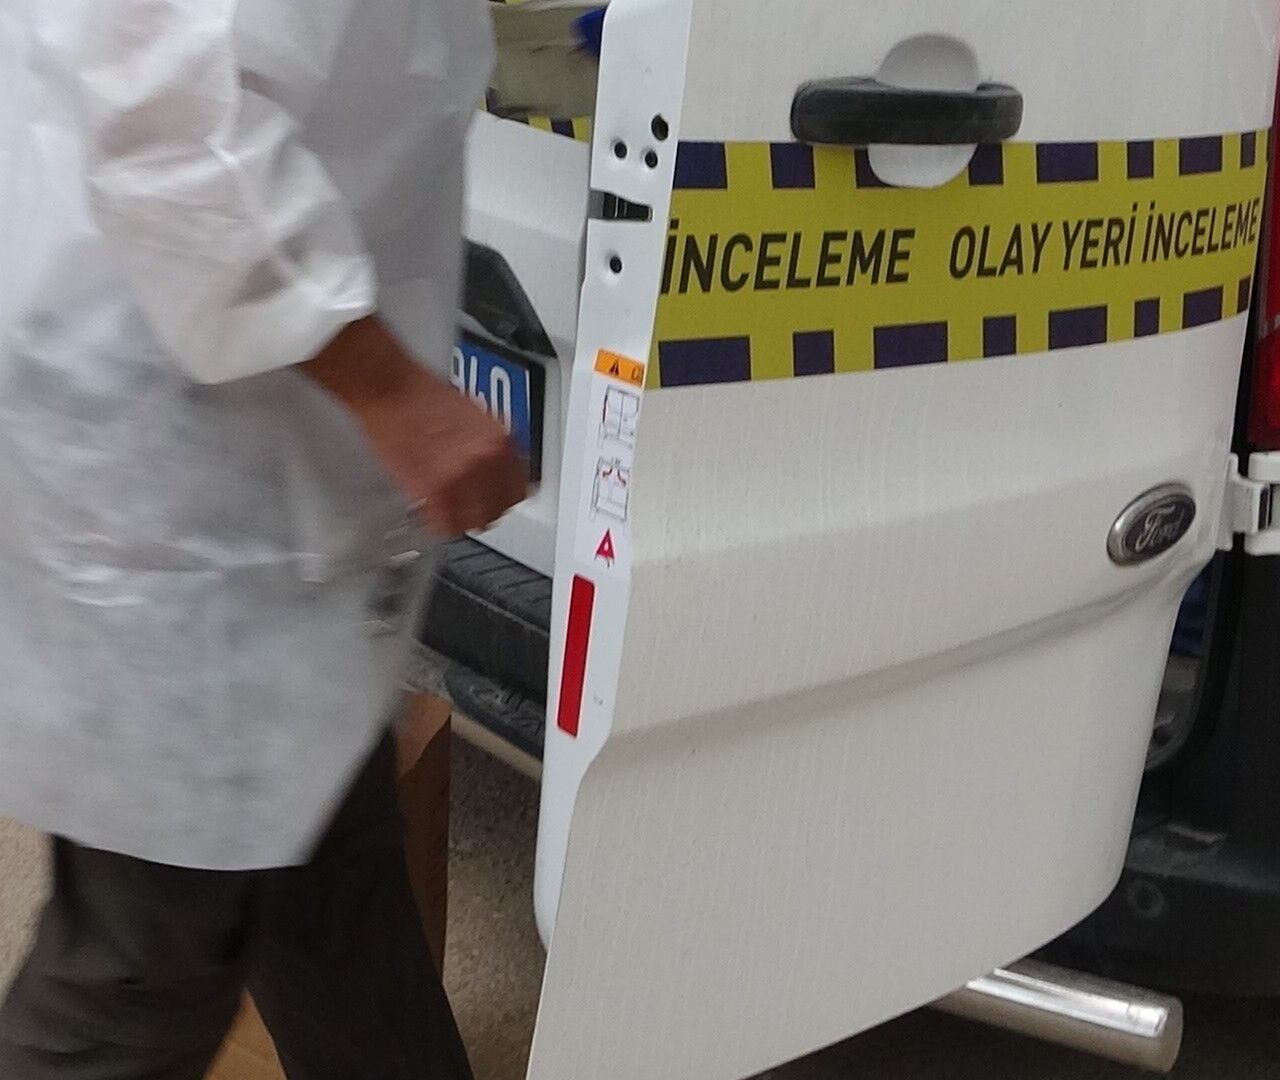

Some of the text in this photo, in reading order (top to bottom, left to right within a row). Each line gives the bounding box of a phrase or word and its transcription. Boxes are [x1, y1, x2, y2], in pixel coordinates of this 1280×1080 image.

[660, 197, 1262, 295] İNCELEME OLAY YERİ İNCELEME
